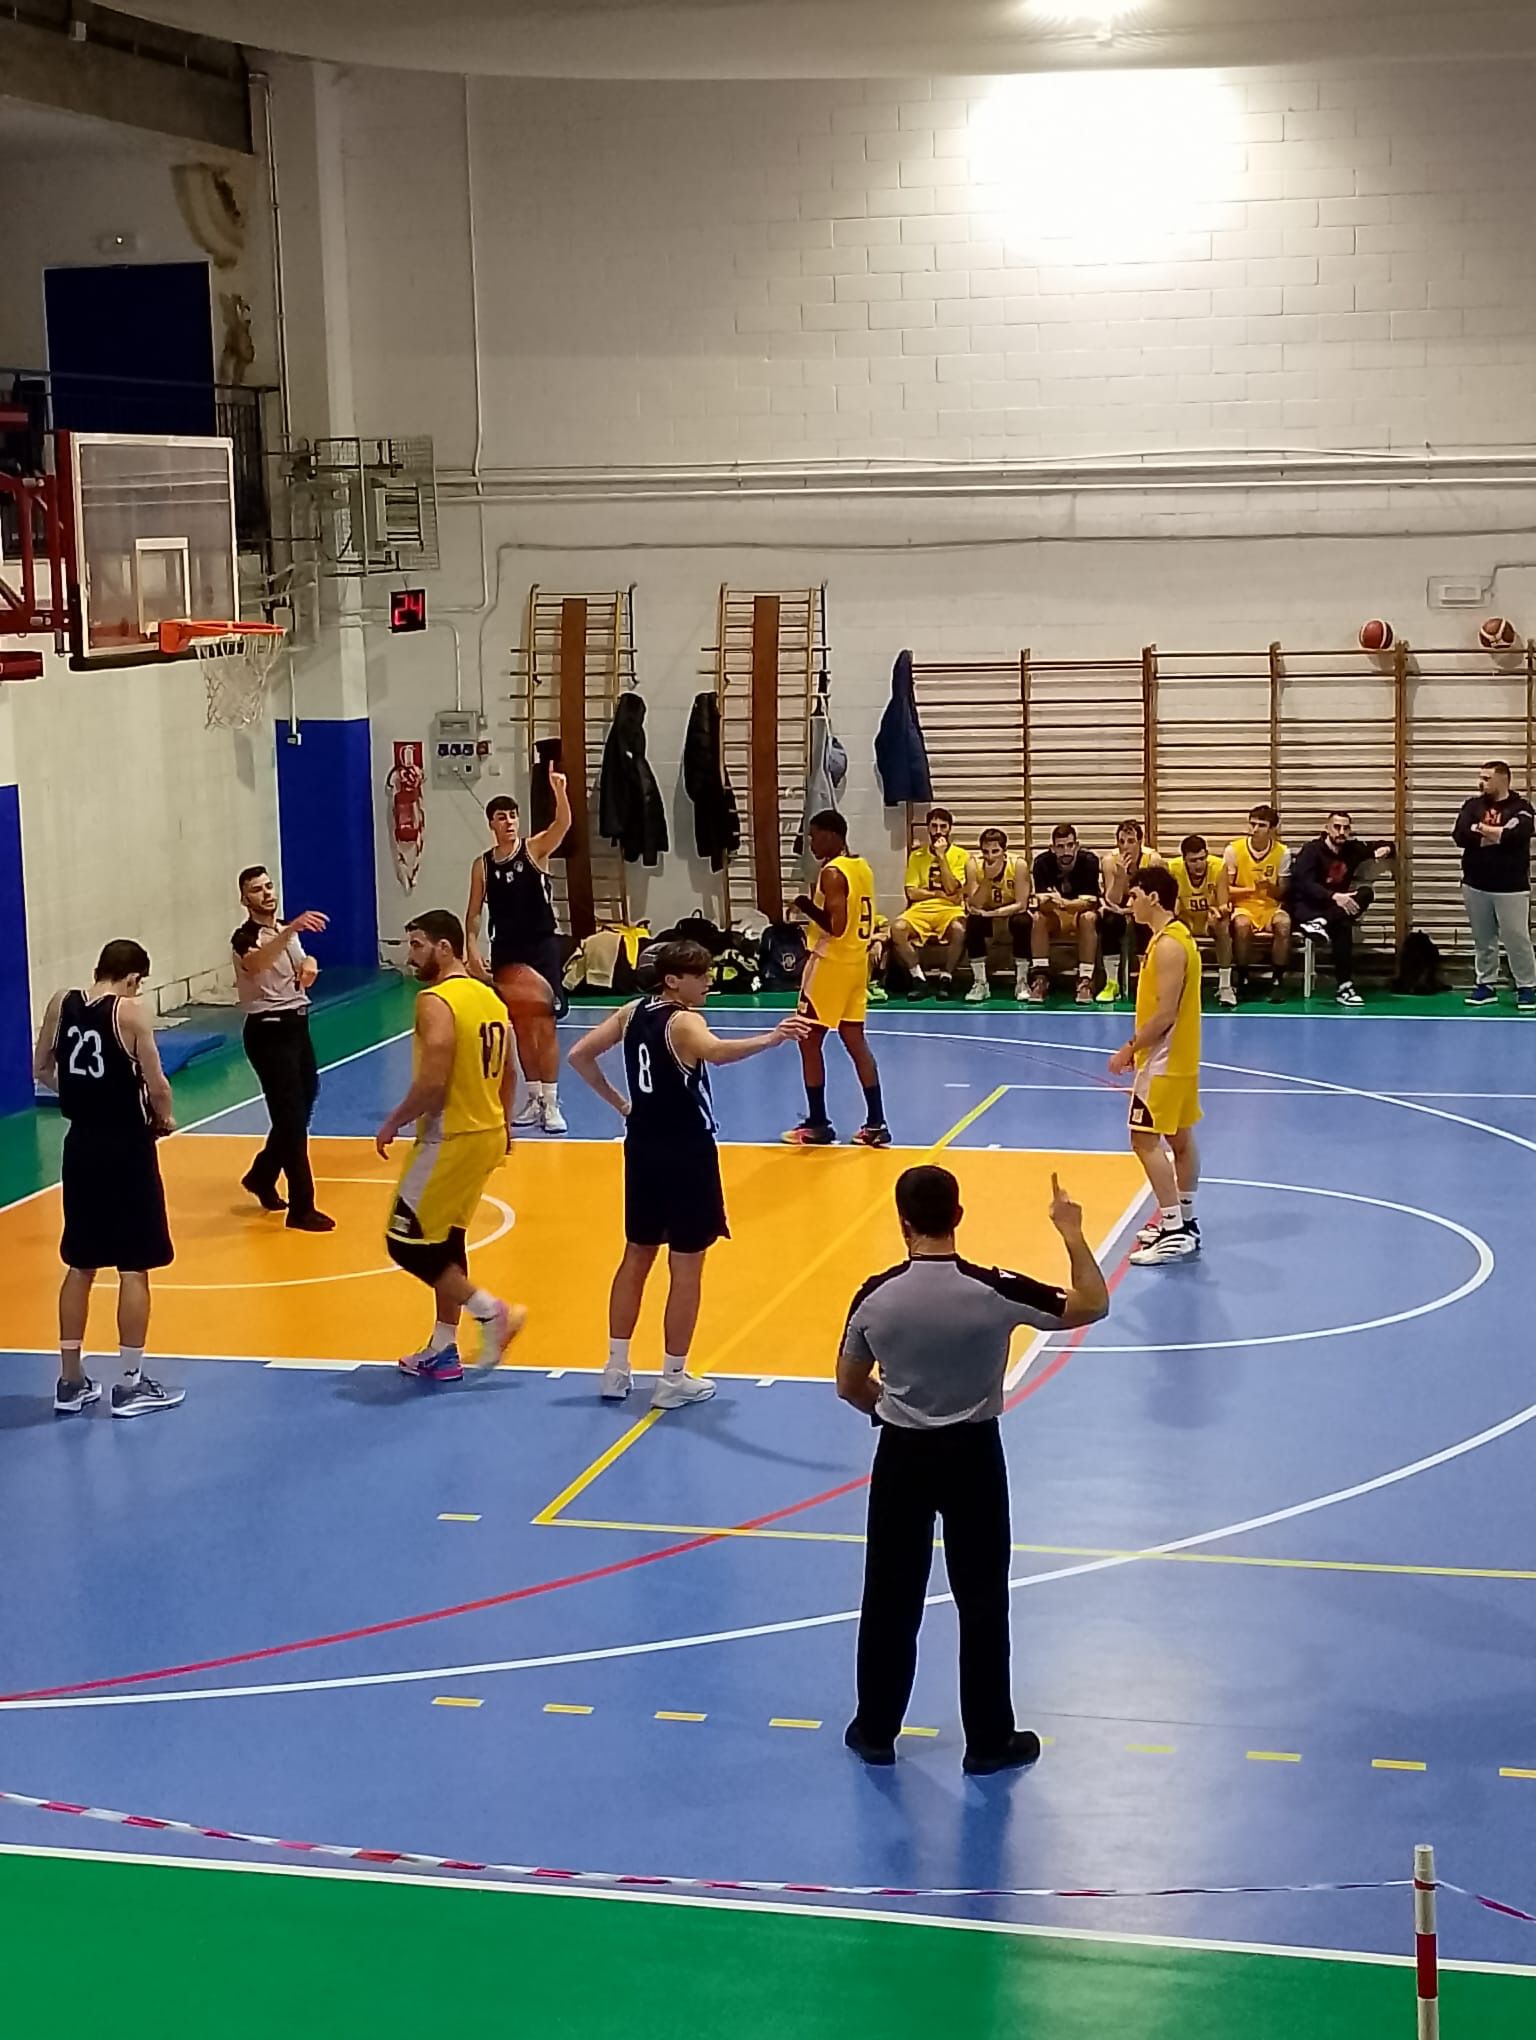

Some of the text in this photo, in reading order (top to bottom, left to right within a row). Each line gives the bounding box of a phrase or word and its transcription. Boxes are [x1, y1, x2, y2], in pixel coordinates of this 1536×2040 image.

[395, 593, 422, 625] 24
[67, 1025, 104, 1078] 23
[638, 1042, 653, 1093] 8
